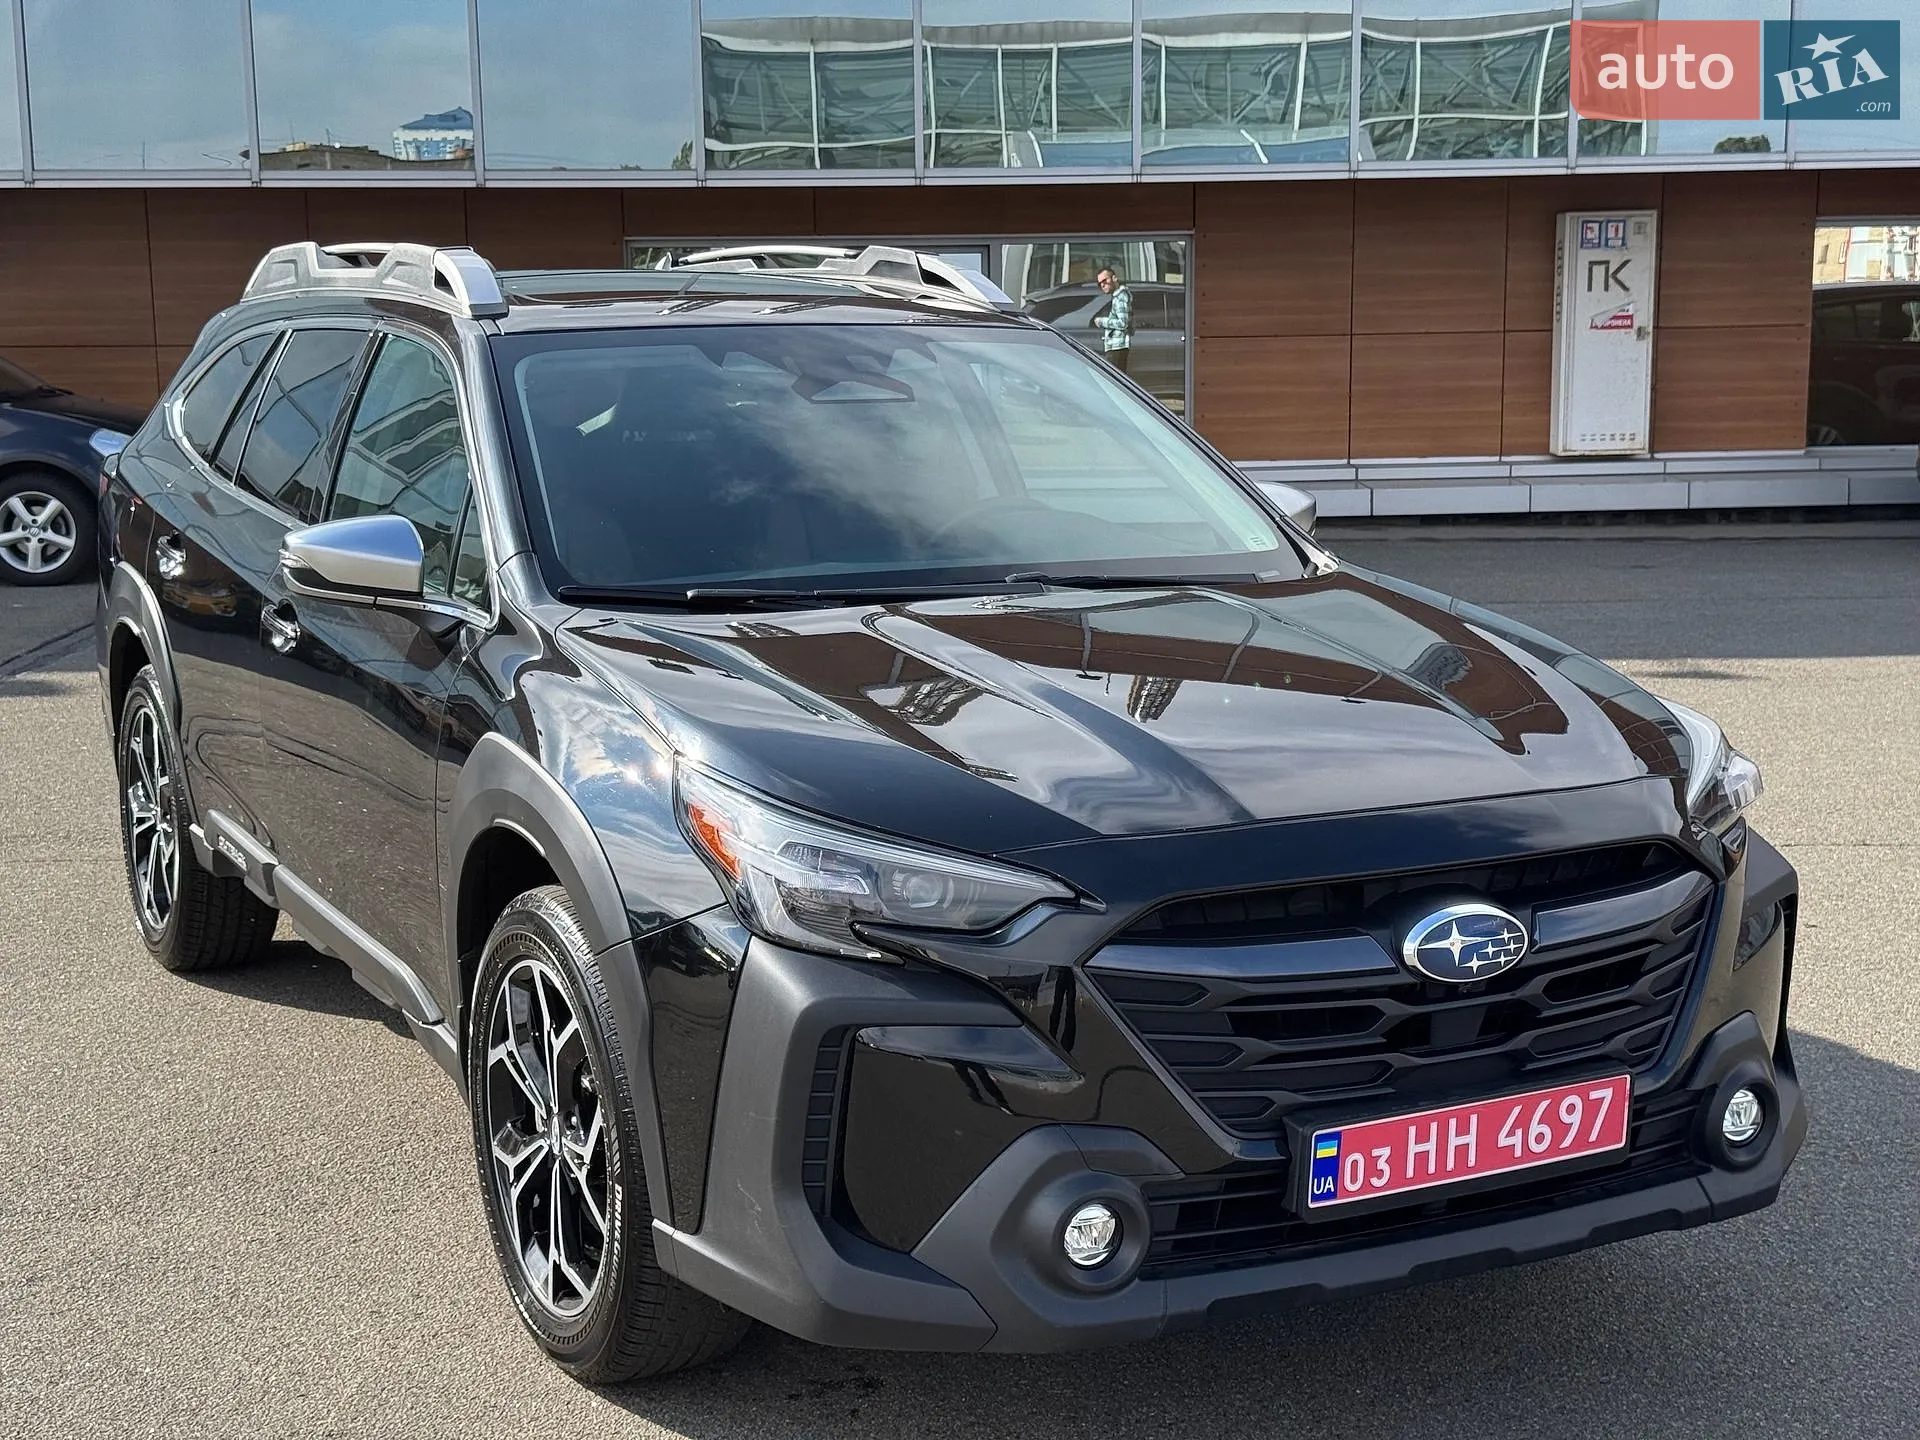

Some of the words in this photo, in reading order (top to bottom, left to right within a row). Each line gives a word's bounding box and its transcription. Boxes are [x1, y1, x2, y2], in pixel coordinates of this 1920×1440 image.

[1587, 259, 1632, 292] ПК
[1343, 1145, 1391, 1193] 03
[1497, 1087, 1615, 1159] 4697
[1313, 1176, 1335, 1196] UA
